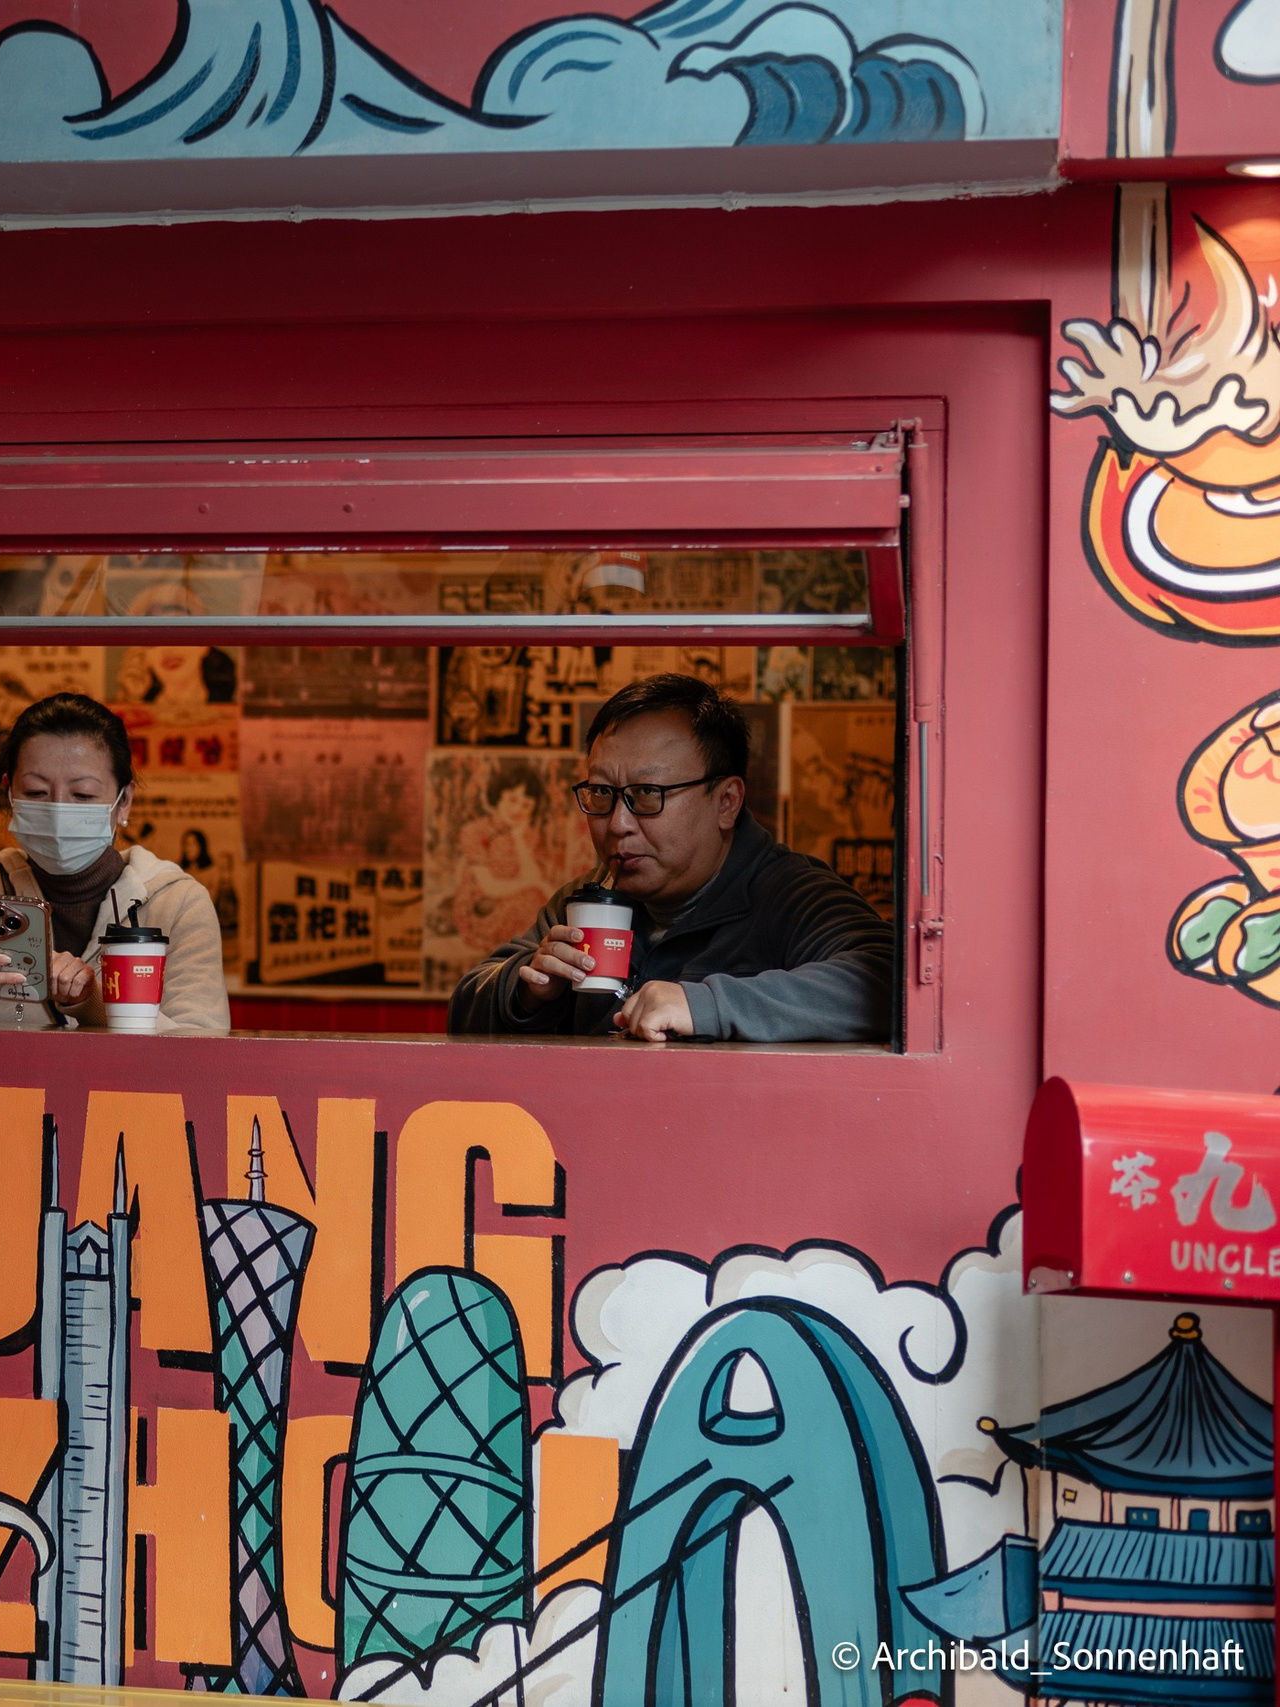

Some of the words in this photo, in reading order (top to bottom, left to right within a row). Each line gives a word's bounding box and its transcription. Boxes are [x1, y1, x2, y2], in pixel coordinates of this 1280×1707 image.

[1109, 1151, 1160, 1211] 茶
[1171, 1131, 1277, 1233] 九
[1171, 1240, 1280, 1277] UNCLE
